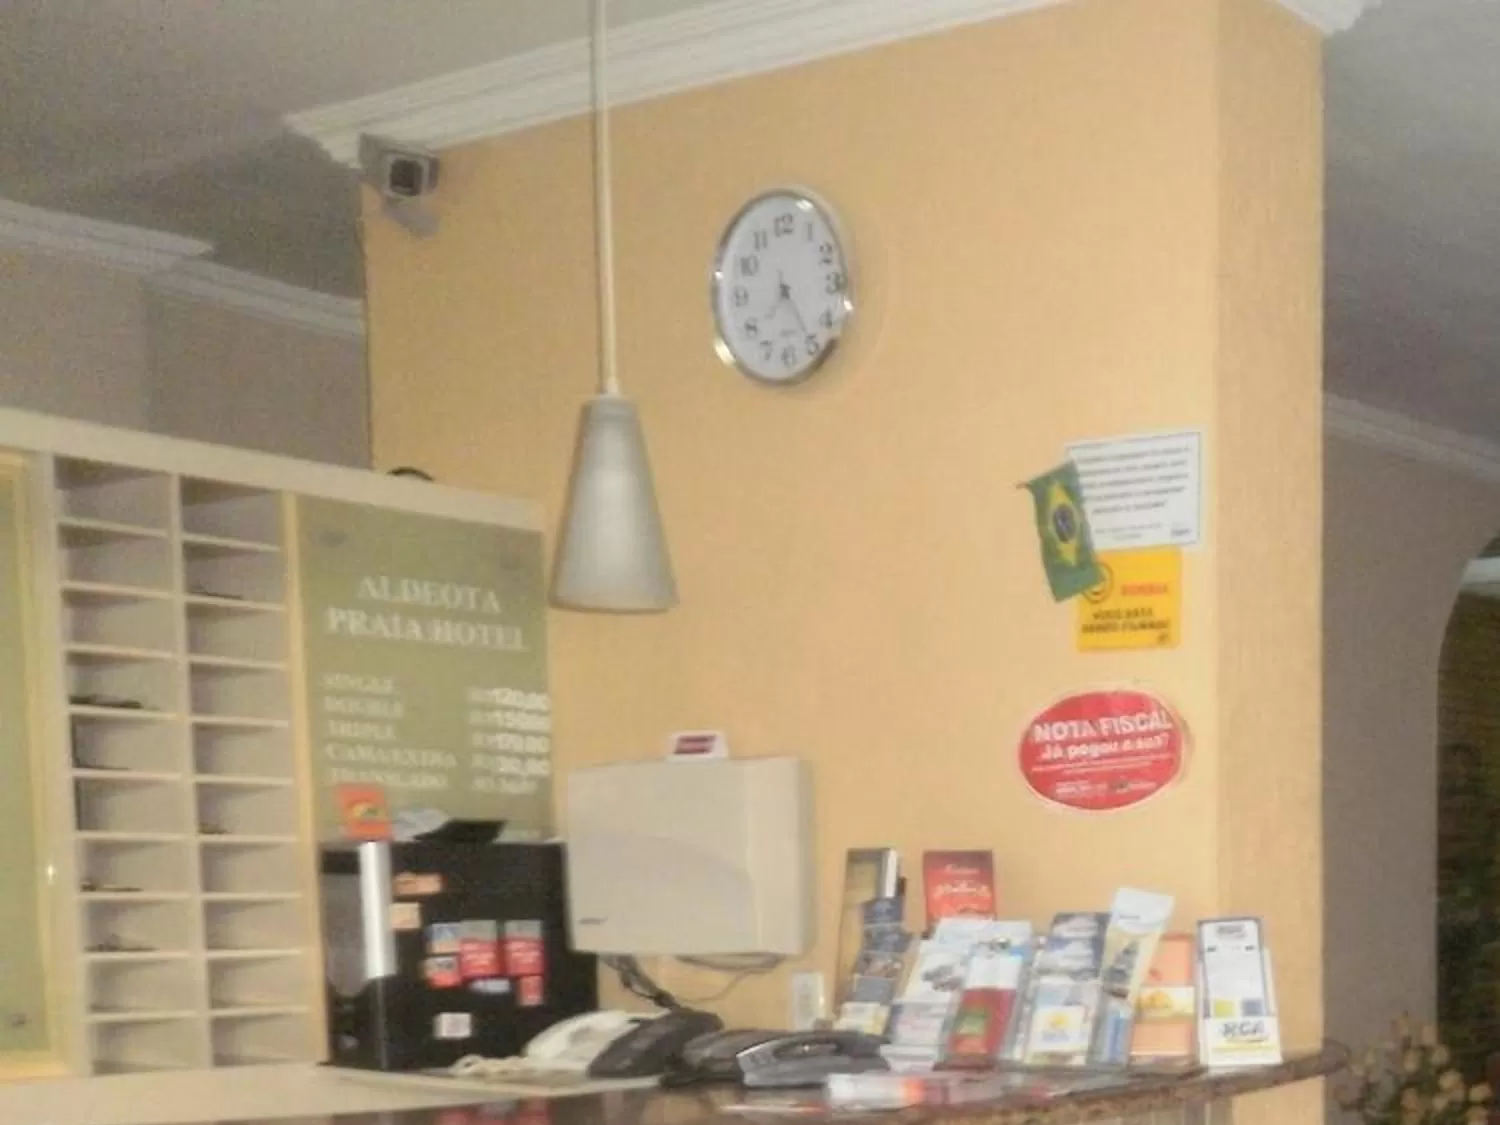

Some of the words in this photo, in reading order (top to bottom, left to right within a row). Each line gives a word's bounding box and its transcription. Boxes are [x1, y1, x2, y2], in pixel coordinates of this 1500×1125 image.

[357, 575, 501, 614] ALDEOTA
[324, 605, 424, 642] PRAIA
[427, 617, 529, 652] HOTEL
[1033, 719, 1097, 743] NOTA
[1099, 709, 1173, 736] FISCAL
